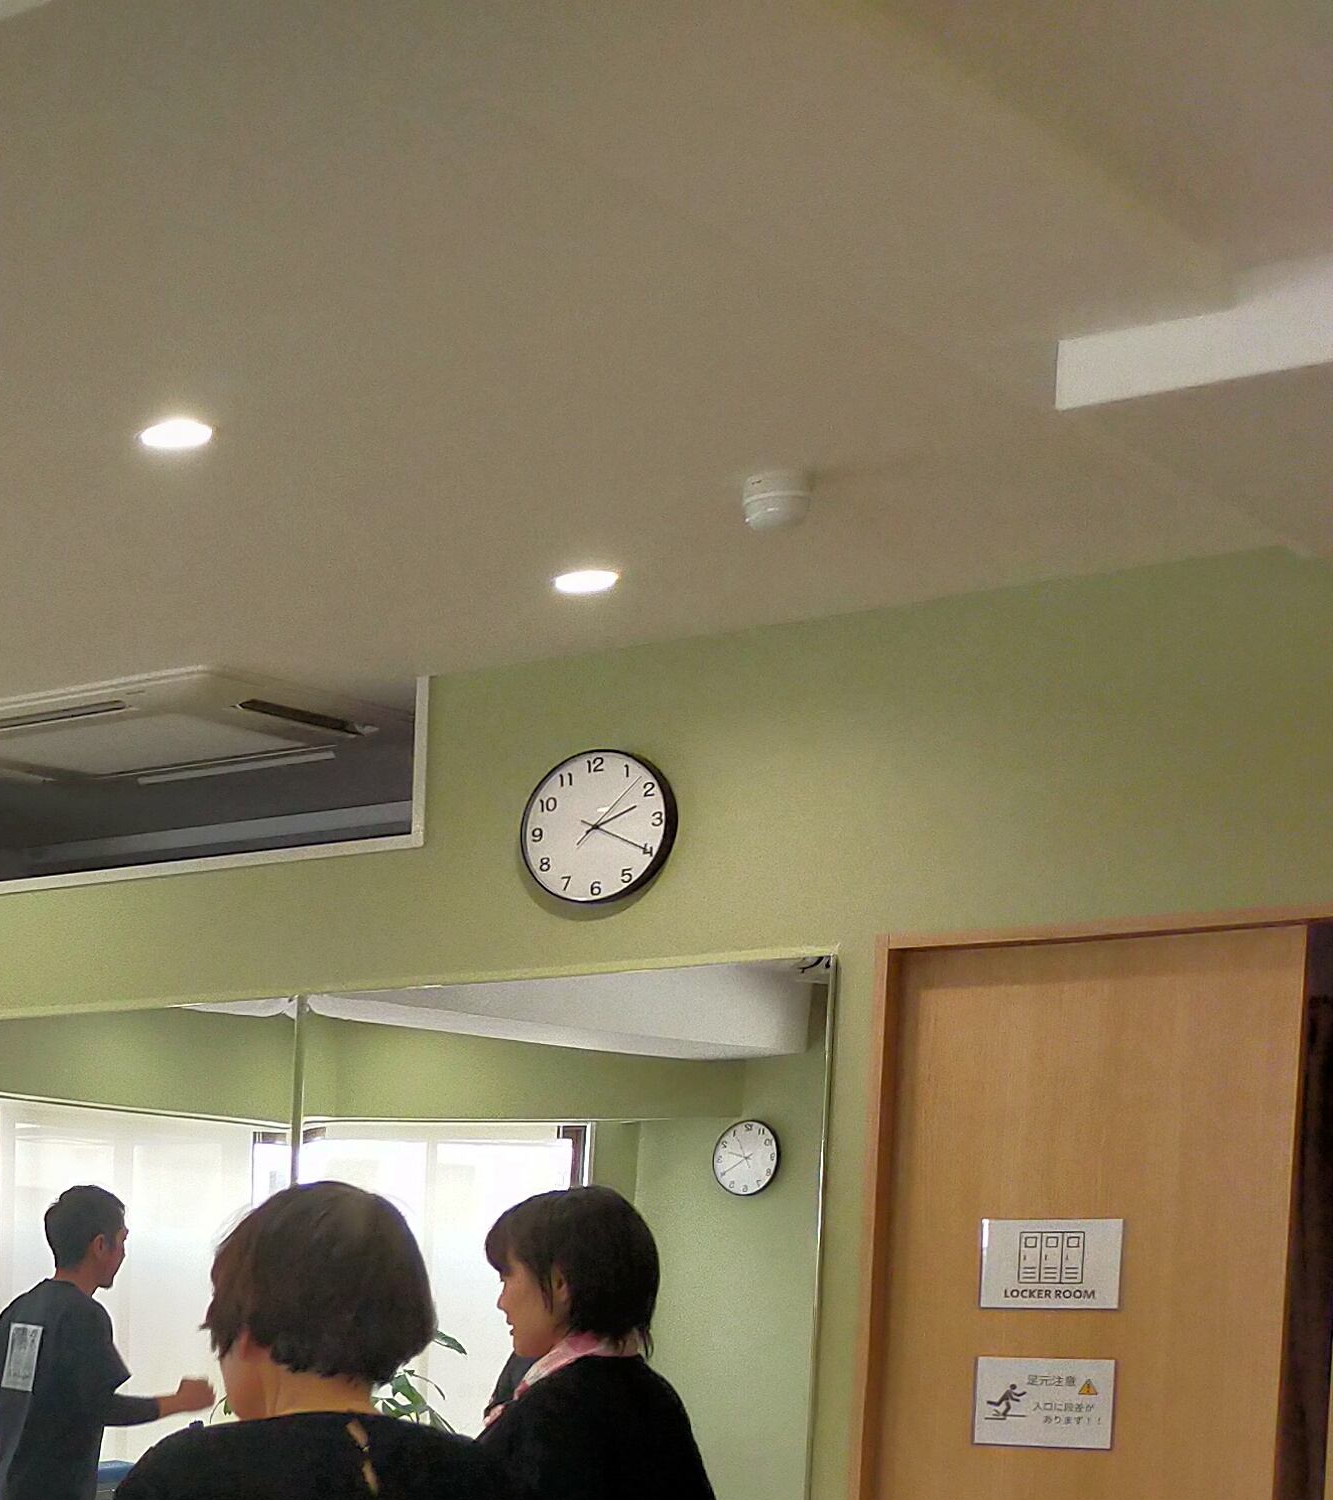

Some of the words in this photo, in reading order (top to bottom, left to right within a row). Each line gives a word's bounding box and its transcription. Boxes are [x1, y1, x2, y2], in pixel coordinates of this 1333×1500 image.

[587, 757, 604, 773] 12
[624, 764, 630, 777] 1
[559, 772, 573, 787] 11
[643, 782, 655, 797] 2
[539, 797, 557, 812] 10
[651, 811, 663, 826] 3
[531, 828, 543, 843] 9
[643, 843, 653, 857] 4
[539, 857, 551, 872] 8
[561, 876, 572, 891] 7
[621, 868, 633, 884] 5
[590, 881, 602, 896] 6
[1004, 1288, 1051, 1299] LOCKER
[1054, 1289, 1096, 1300] ROOM
[1026, 1375, 1077, 1387] 足元注意
[1032, 1401, 1095, 1413] 入口に段差が
